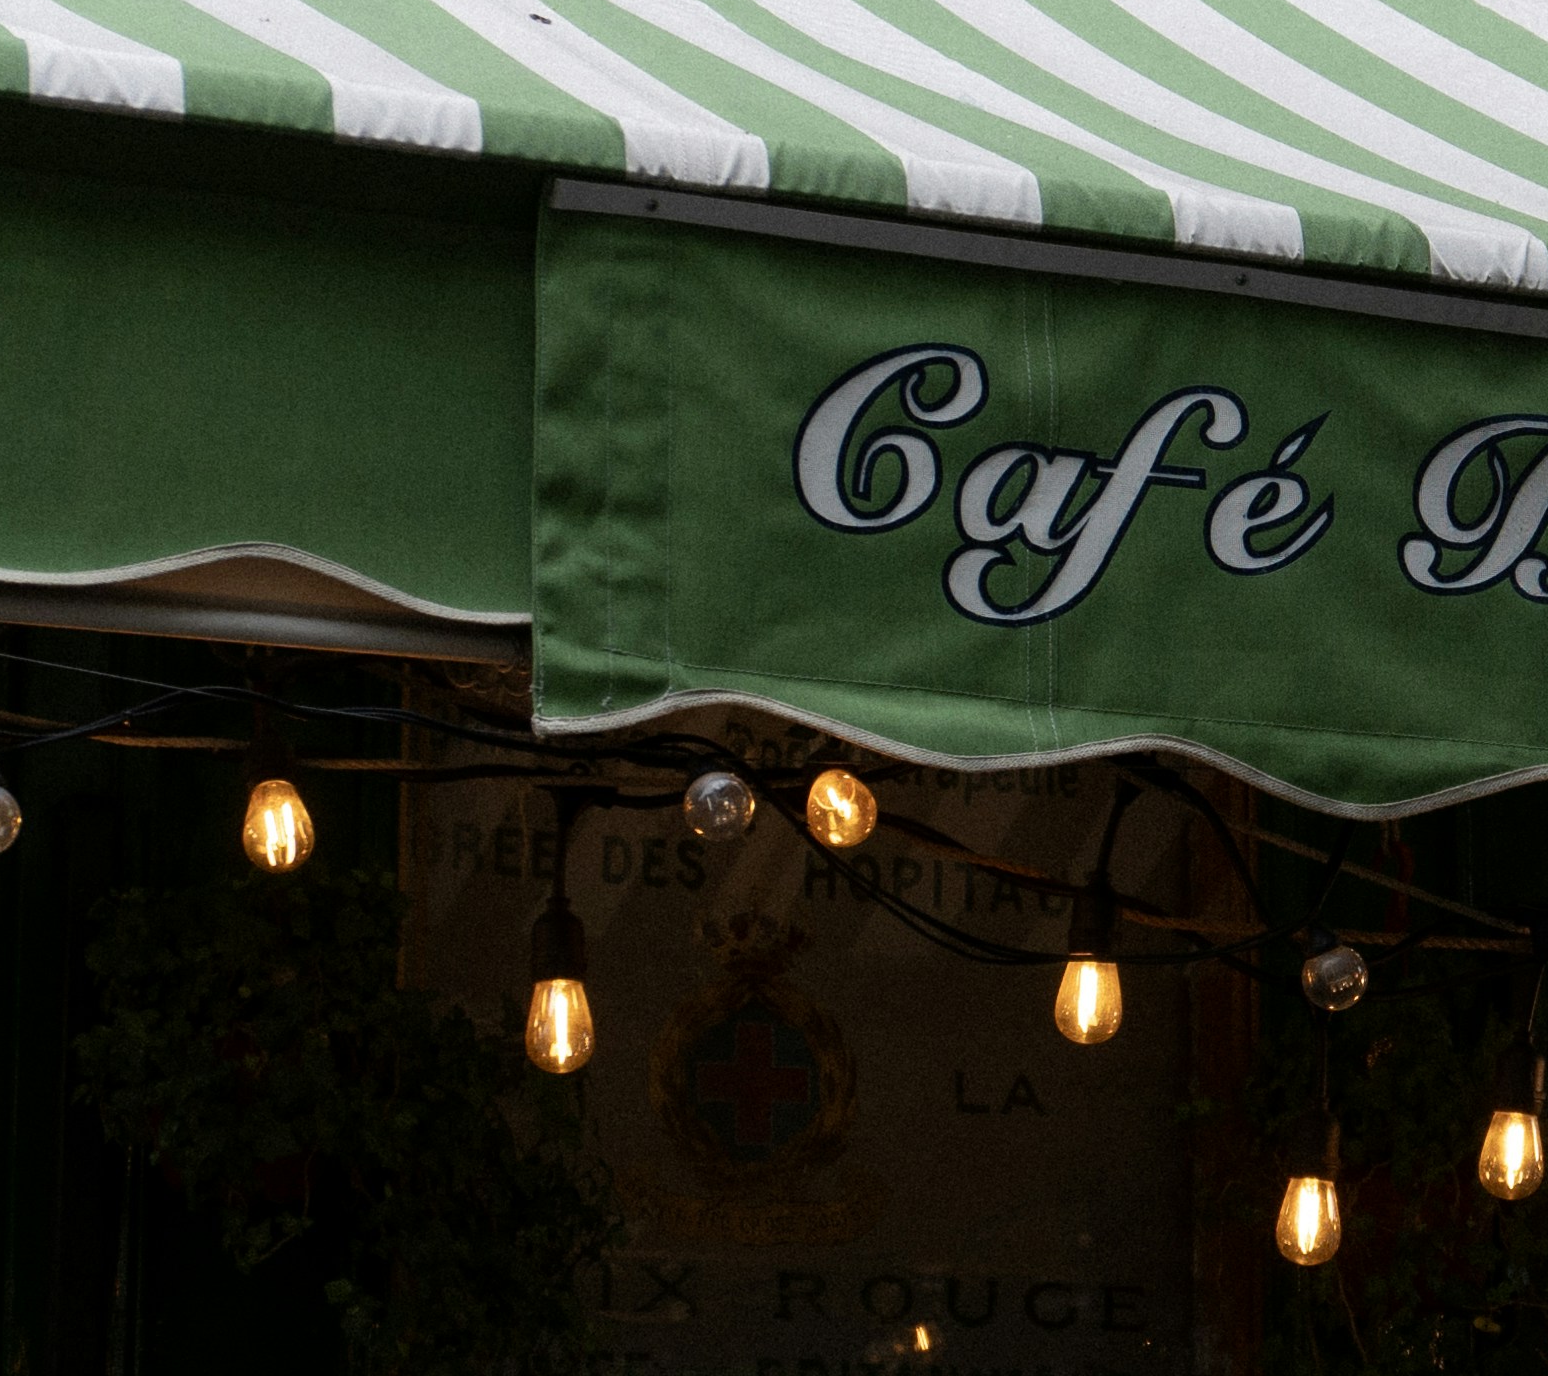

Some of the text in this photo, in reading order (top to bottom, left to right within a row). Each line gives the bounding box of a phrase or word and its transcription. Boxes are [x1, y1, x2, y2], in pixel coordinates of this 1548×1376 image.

[793, 342, 1335, 626] Café
[602, 834, 706, 891] DES
[953, 1070, 1045, 1118] LA
[773, 1268, 1153, 1331] ROUGE
